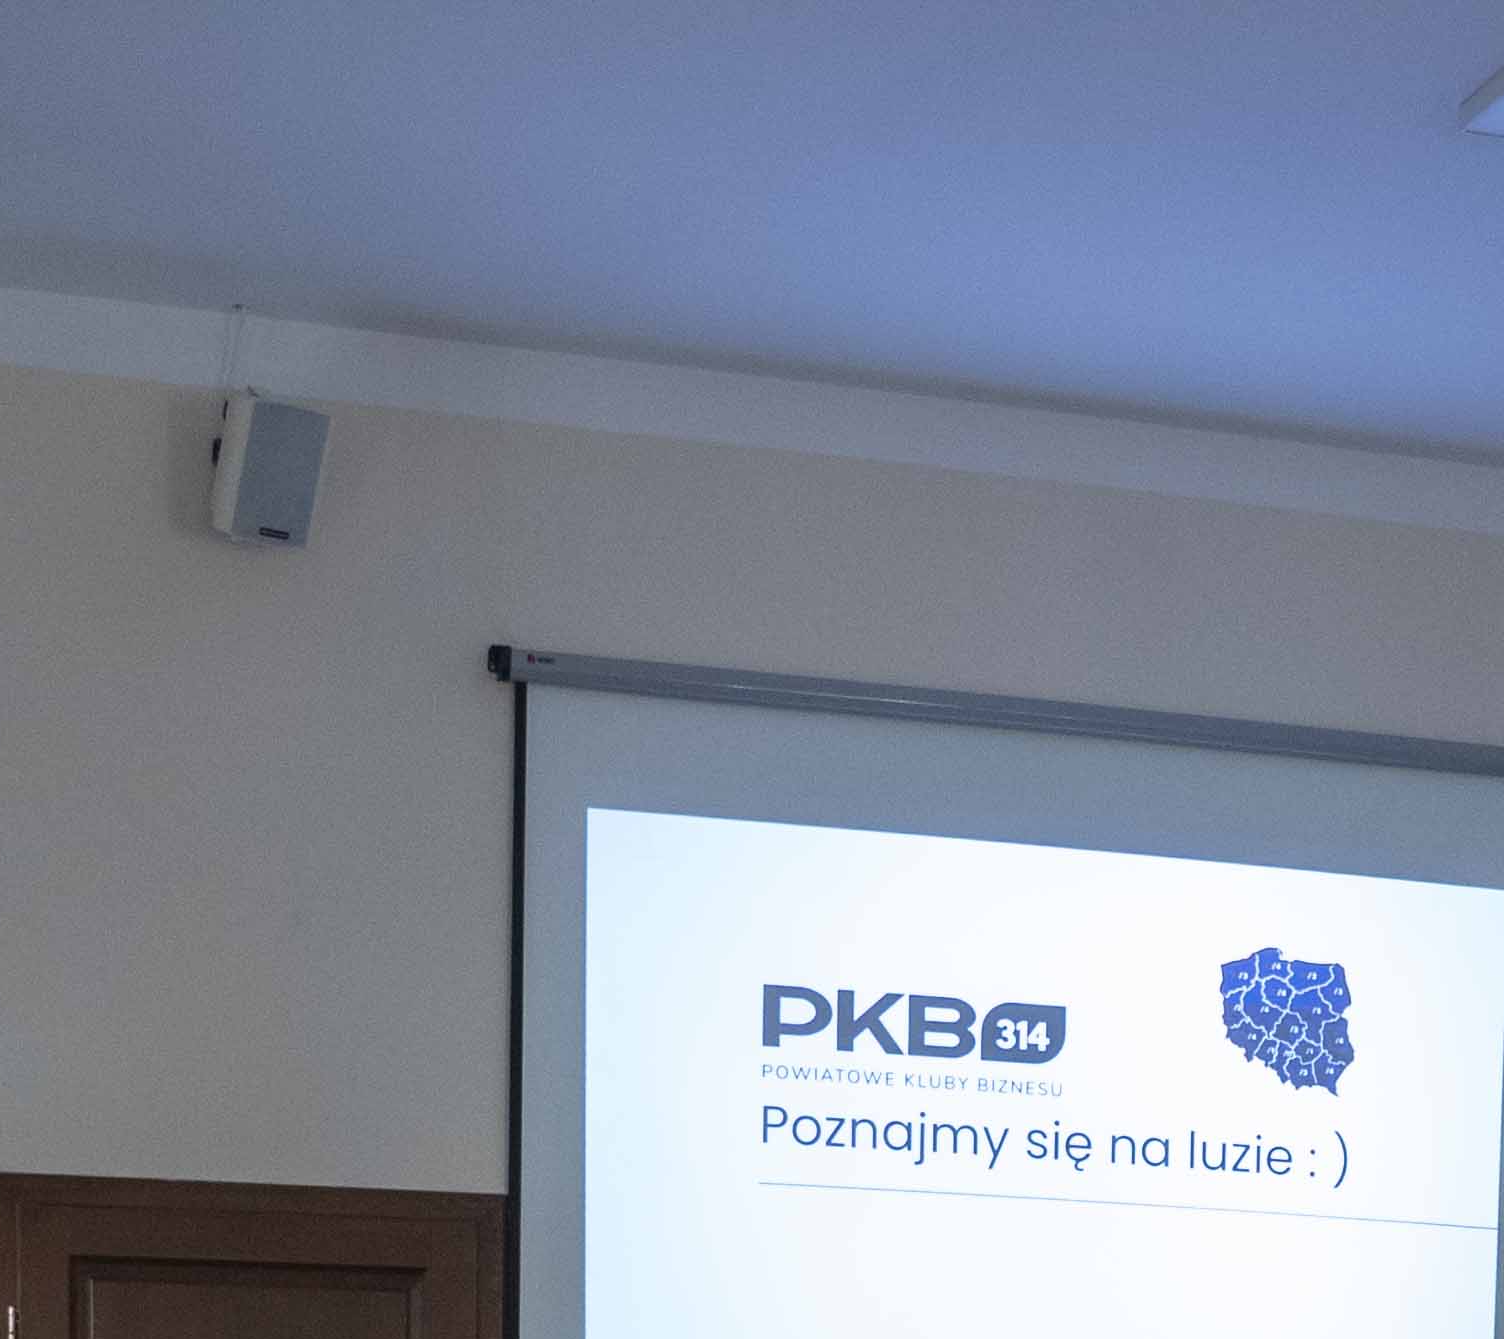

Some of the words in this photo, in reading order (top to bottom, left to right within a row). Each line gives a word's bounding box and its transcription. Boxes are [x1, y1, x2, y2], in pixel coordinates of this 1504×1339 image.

[762, 983, 977, 1060] PKB
[995, 1018, 1051, 1052] 314
[761, 1063, 895, 1087] POWIATOWE
[904, 1073, 970, 1091] KLUBY
[977, 1077, 1064, 1097] BIZNESU
[762, 1104, 1010, 1170] Poznajmy
[1026, 1119, 1093, 1172] się
[1110, 1134, 1170, 1168] na
[1189, 1130, 1293, 1176] luzie
